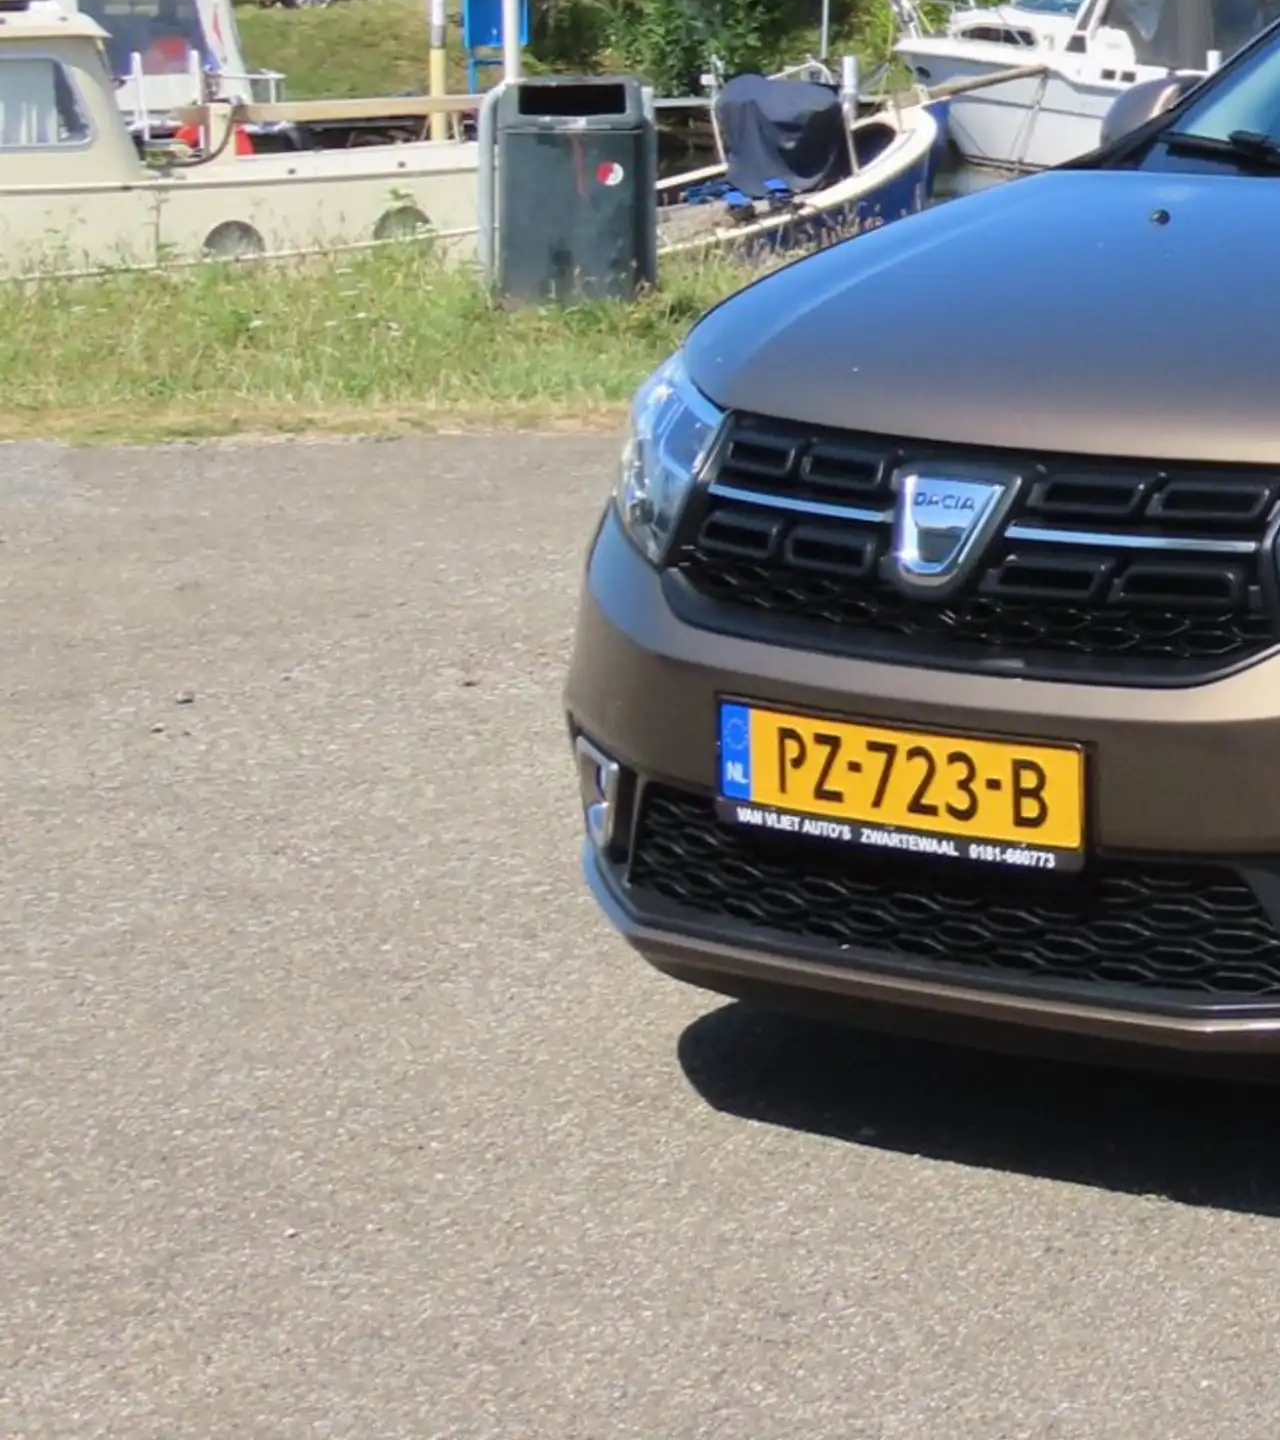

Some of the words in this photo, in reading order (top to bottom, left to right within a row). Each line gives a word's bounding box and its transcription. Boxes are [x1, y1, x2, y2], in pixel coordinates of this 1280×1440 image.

[913, 492, 976, 512] DACIA
[726, 760, 749, 785] NL
[777, 726, 1049, 829] PZ-723-B
[736, 805, 763, 825] VAN
[764, 811, 800, 831] VLIET
[802, 818, 852, 840] AUTO'S
[860, 827, 960, 857] ZWARTEWAAL
